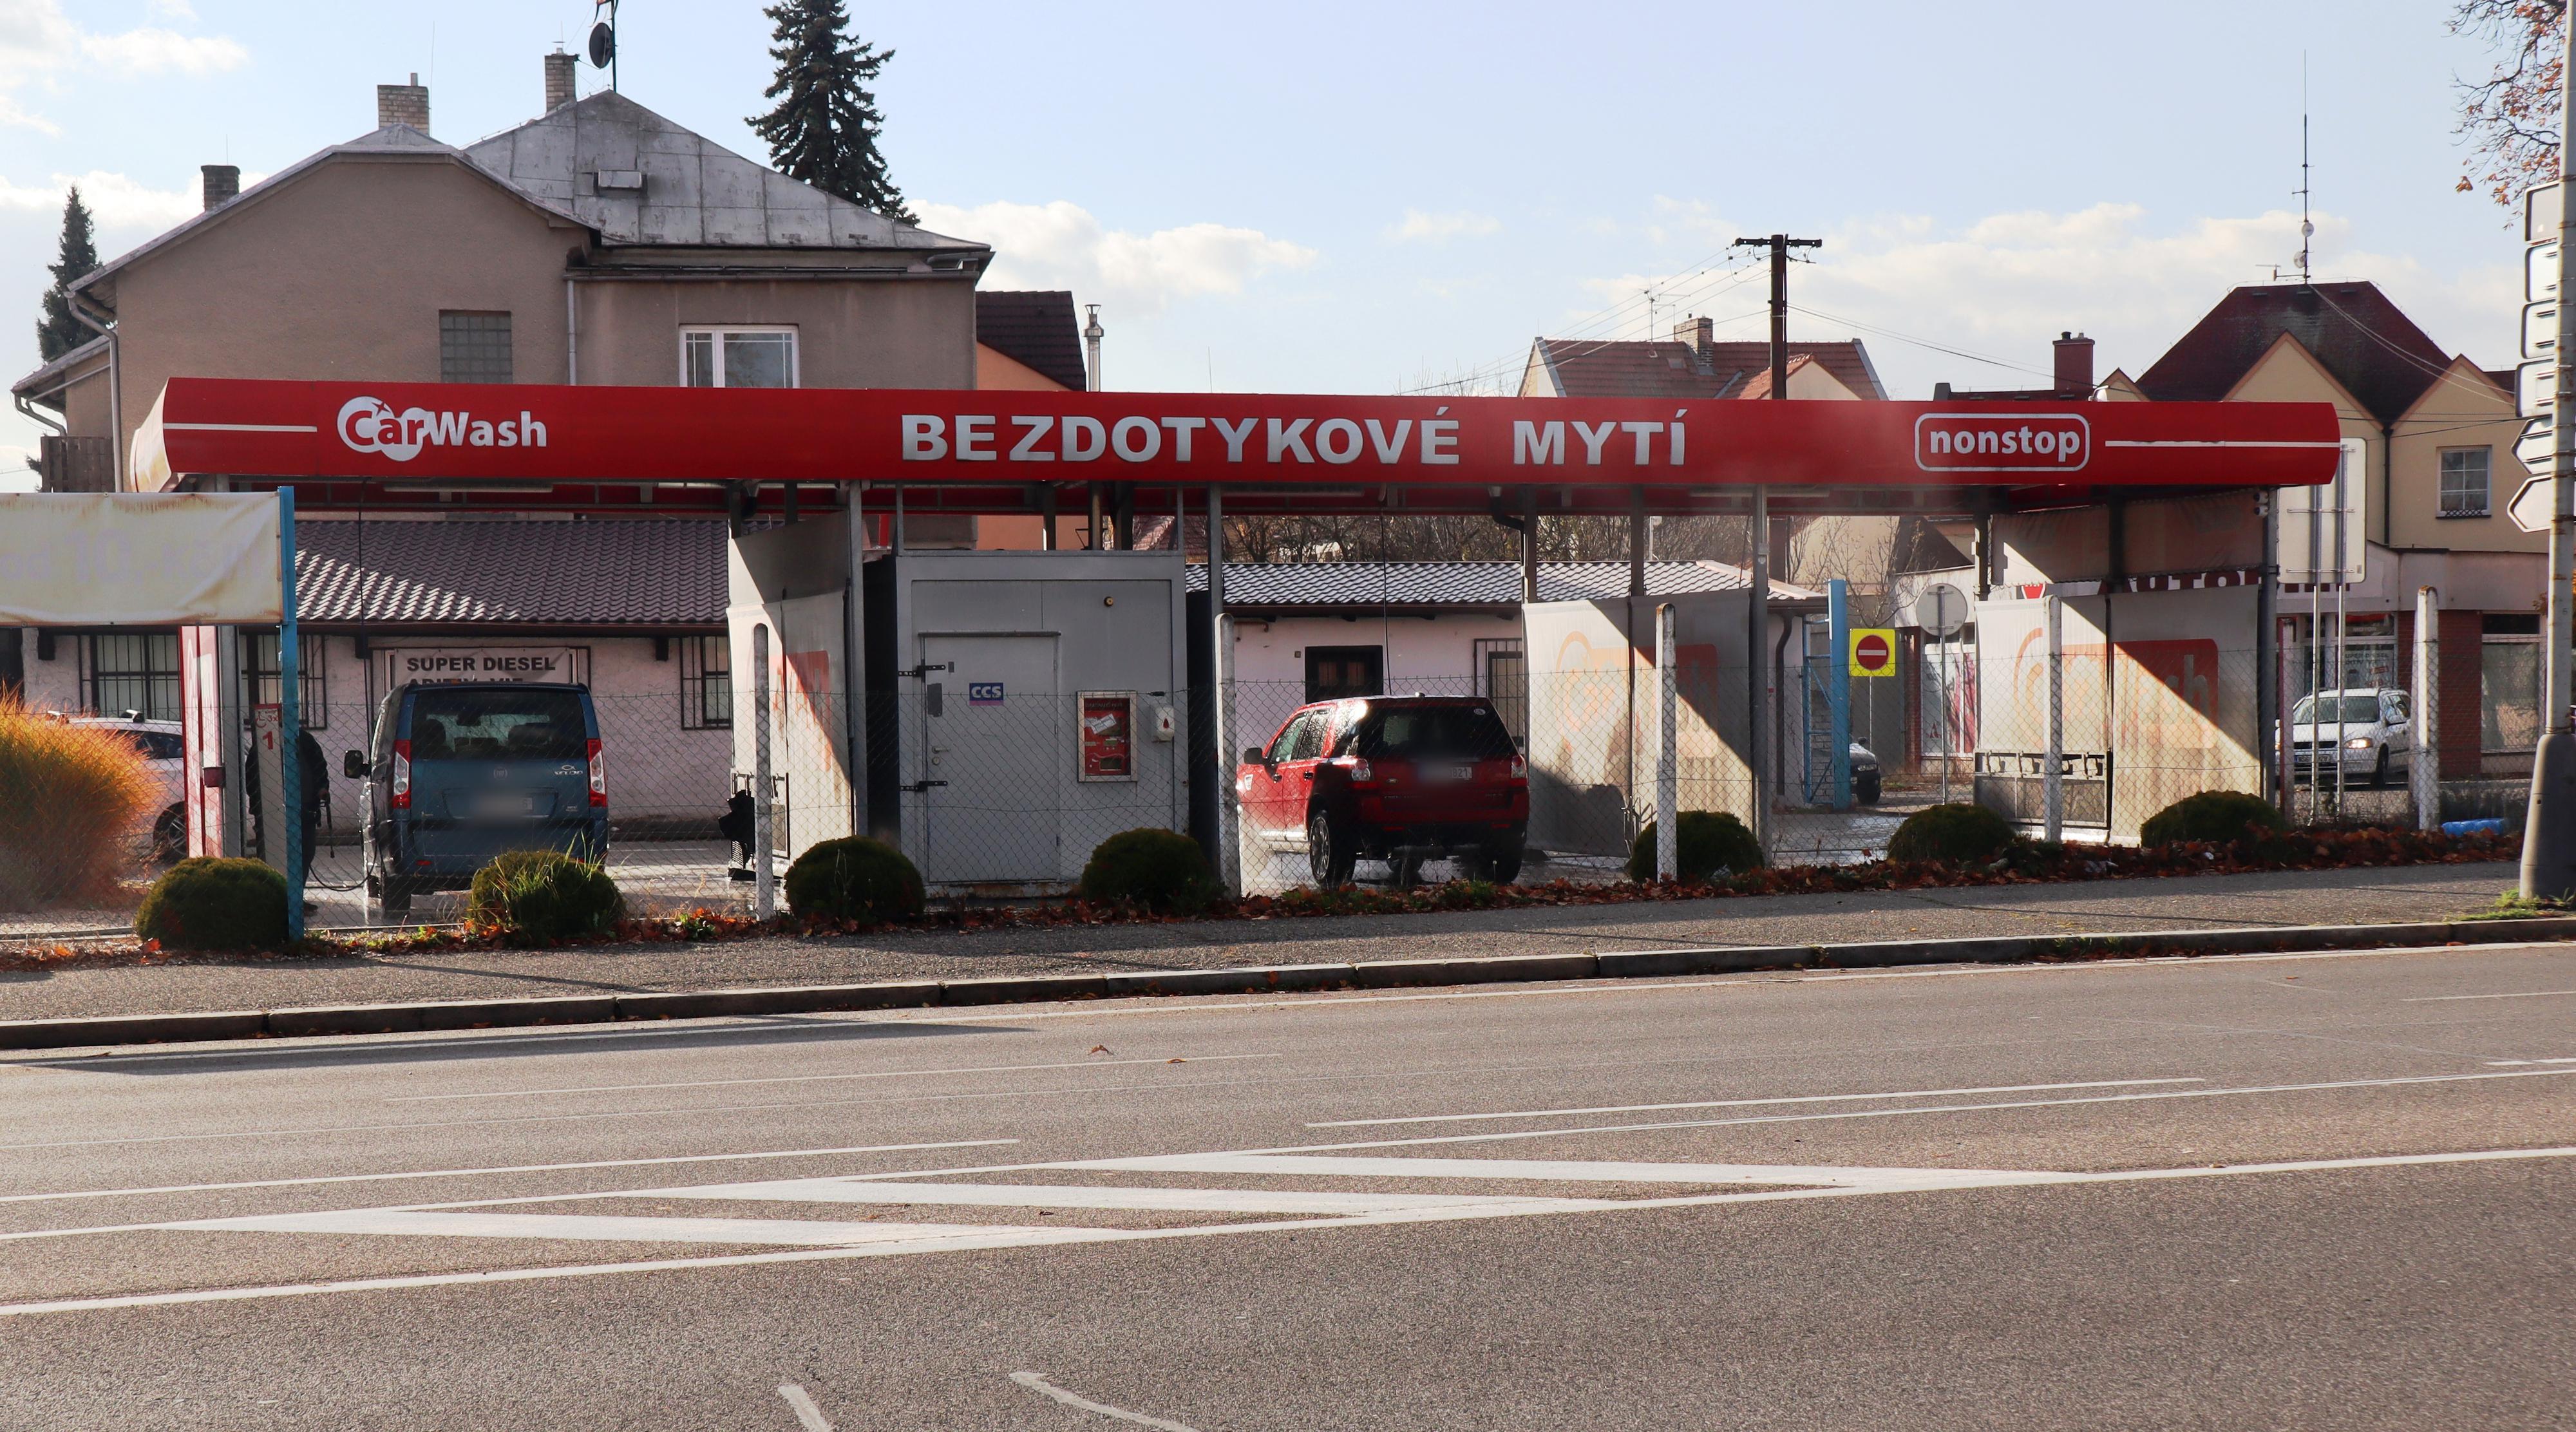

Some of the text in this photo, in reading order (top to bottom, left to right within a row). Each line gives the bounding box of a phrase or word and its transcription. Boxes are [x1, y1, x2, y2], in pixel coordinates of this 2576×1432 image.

[344, 408, 547, 448] CarWash
[902, 406, 1687, 466] BEZDOTYKOVÉ MYTÍ
[1930, 426, 2080, 462] nonstop
[407, 657, 556, 671] SUPER DIESEL
[972, 686, 1001, 698] CCS
